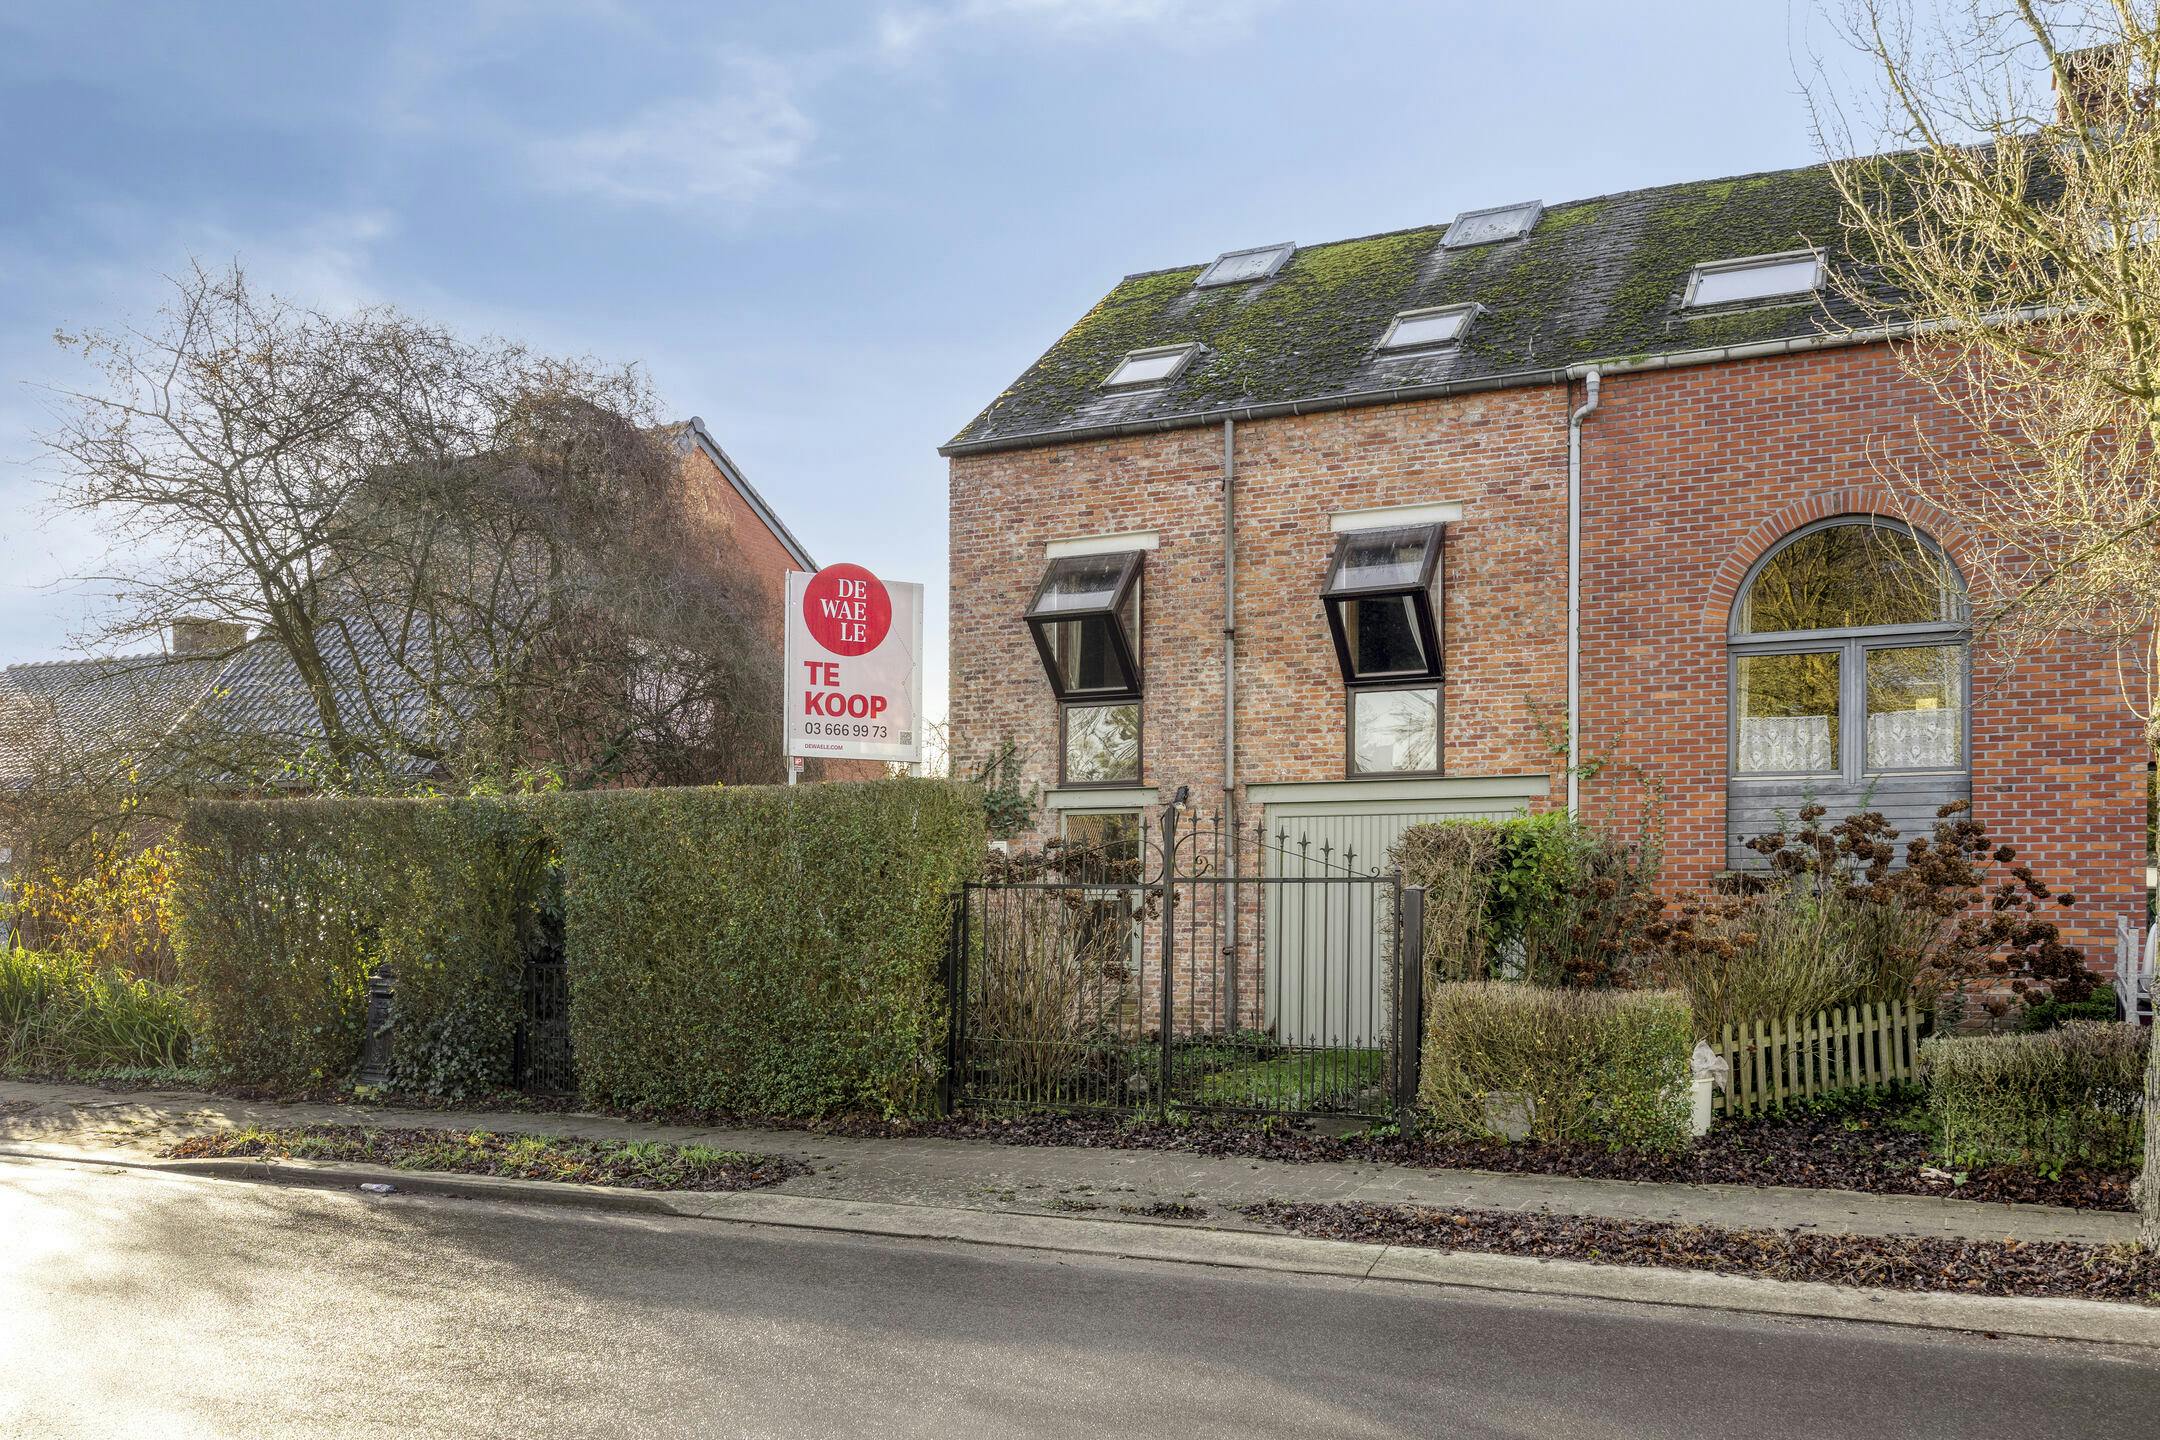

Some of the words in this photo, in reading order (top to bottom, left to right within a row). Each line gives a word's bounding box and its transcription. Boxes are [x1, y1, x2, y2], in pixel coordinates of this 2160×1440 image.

[838, 578, 867, 599] DE
[820, 598, 867, 620] WAE
[840, 622, 867, 643] LE
[804, 660, 840, 687] TE
[805, 691, 887, 719] KOOP
[804, 721, 821, 735] 03
[824, 723, 850, 736] 666
[852, 724, 869, 737] 99
[872, 725, 888, 738] 73
[804, 743, 844, 751] DEWAELE.COM
